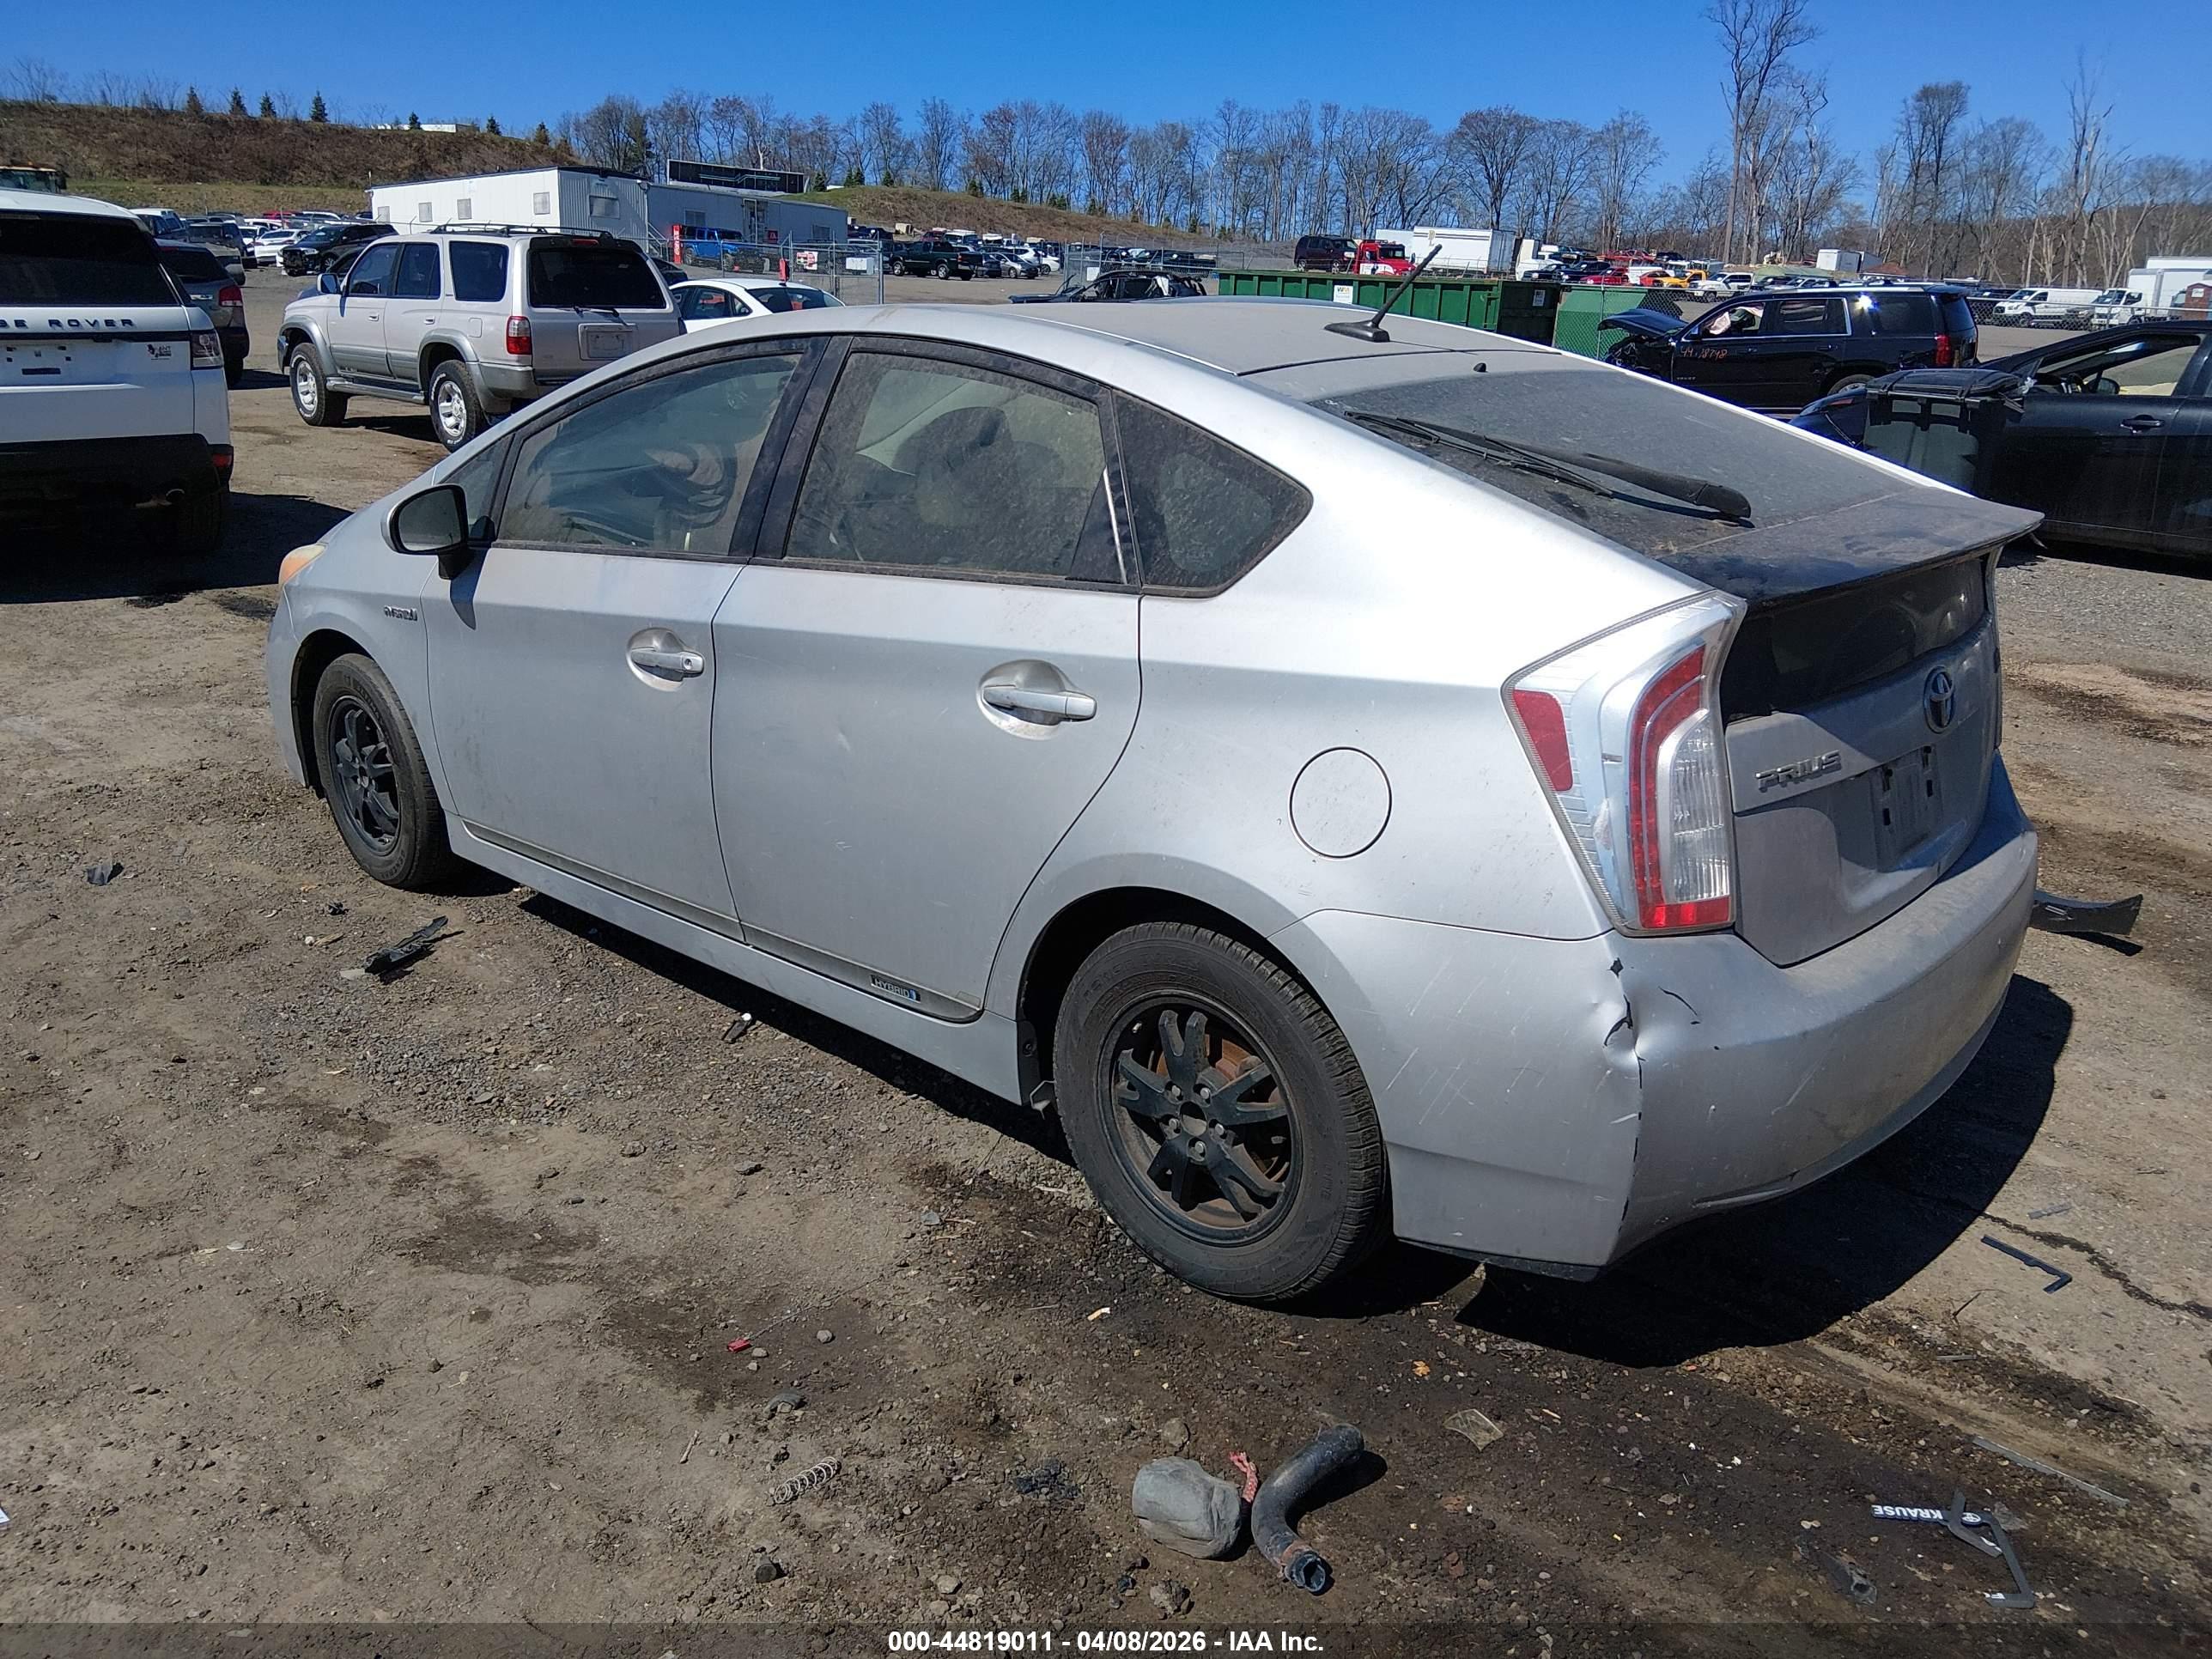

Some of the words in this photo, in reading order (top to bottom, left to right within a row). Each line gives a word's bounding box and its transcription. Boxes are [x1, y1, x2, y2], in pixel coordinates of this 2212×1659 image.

[48, 319, 134, 327] ROVER
[1755, 749, 1840, 789] PRIUS
[874, 978, 911, 999] HYBRID
[1871, 1504, 1943, 1520] KRAUSE
